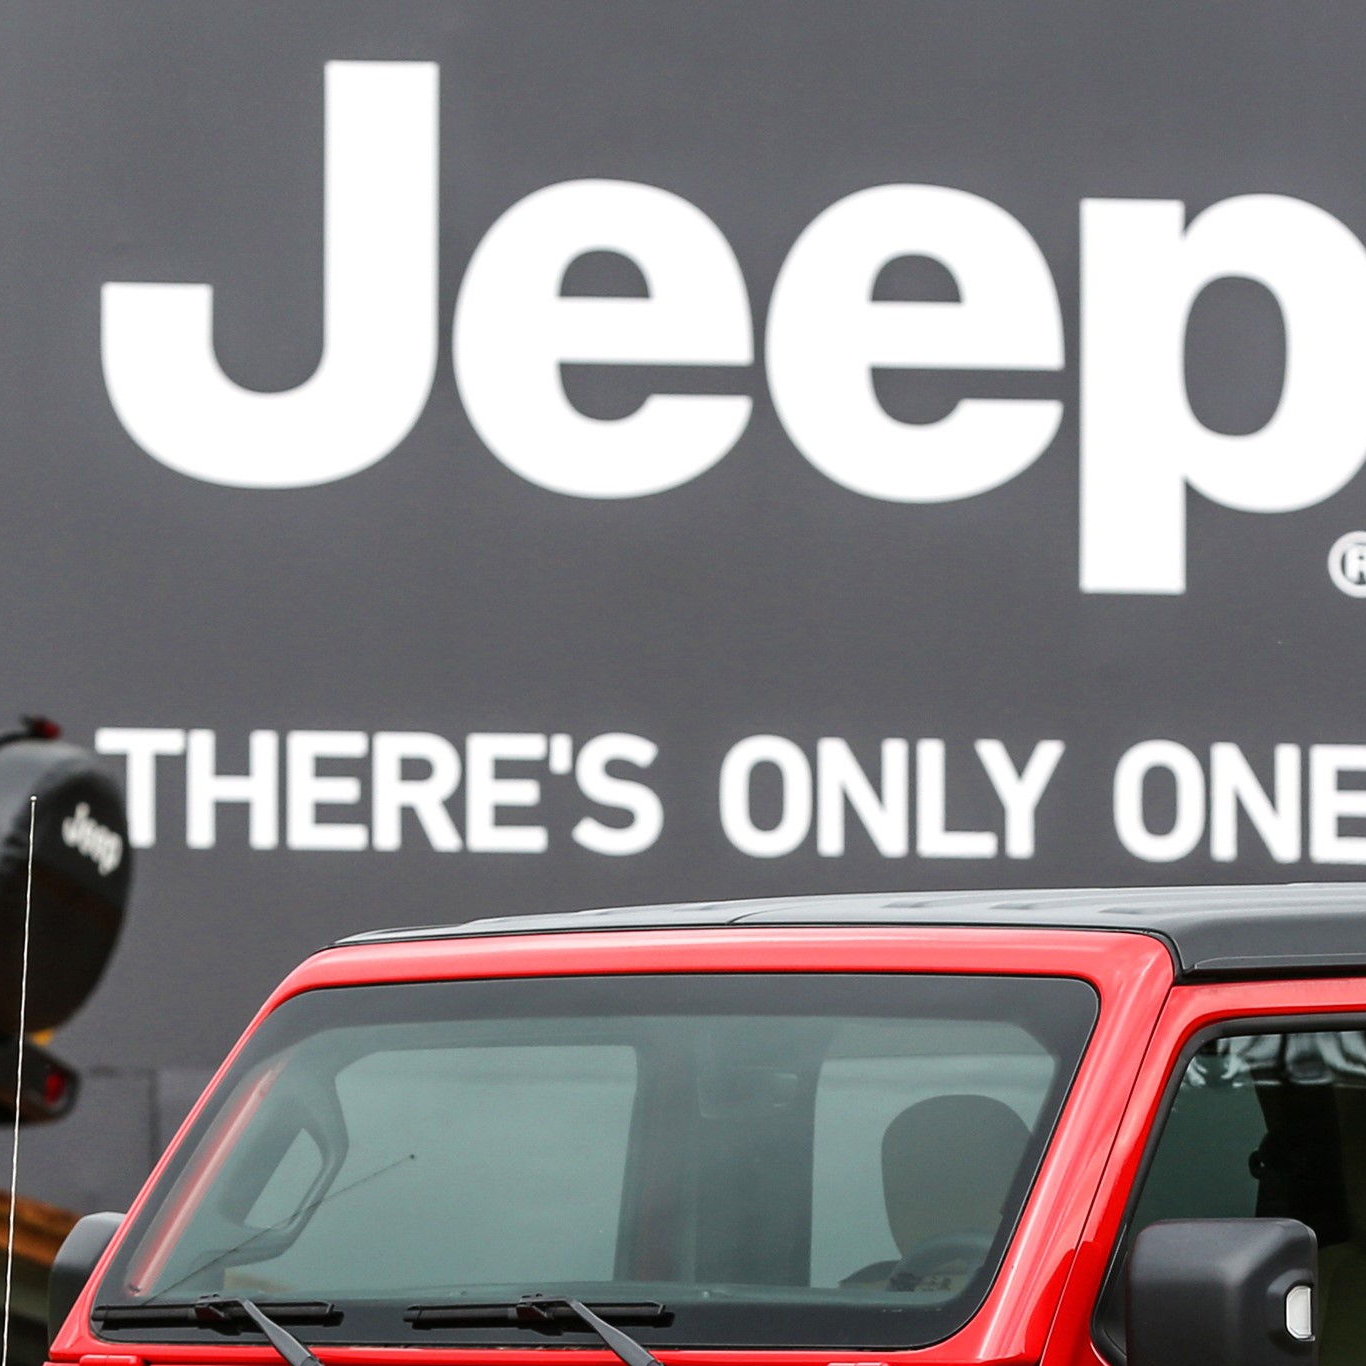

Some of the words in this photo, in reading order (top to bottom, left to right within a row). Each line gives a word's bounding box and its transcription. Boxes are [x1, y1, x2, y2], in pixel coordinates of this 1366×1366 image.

[61, 802, 123, 877] Jeep
[94, 727, 665, 856] THERE'S
[718, 734, 1066, 859] ONLY
